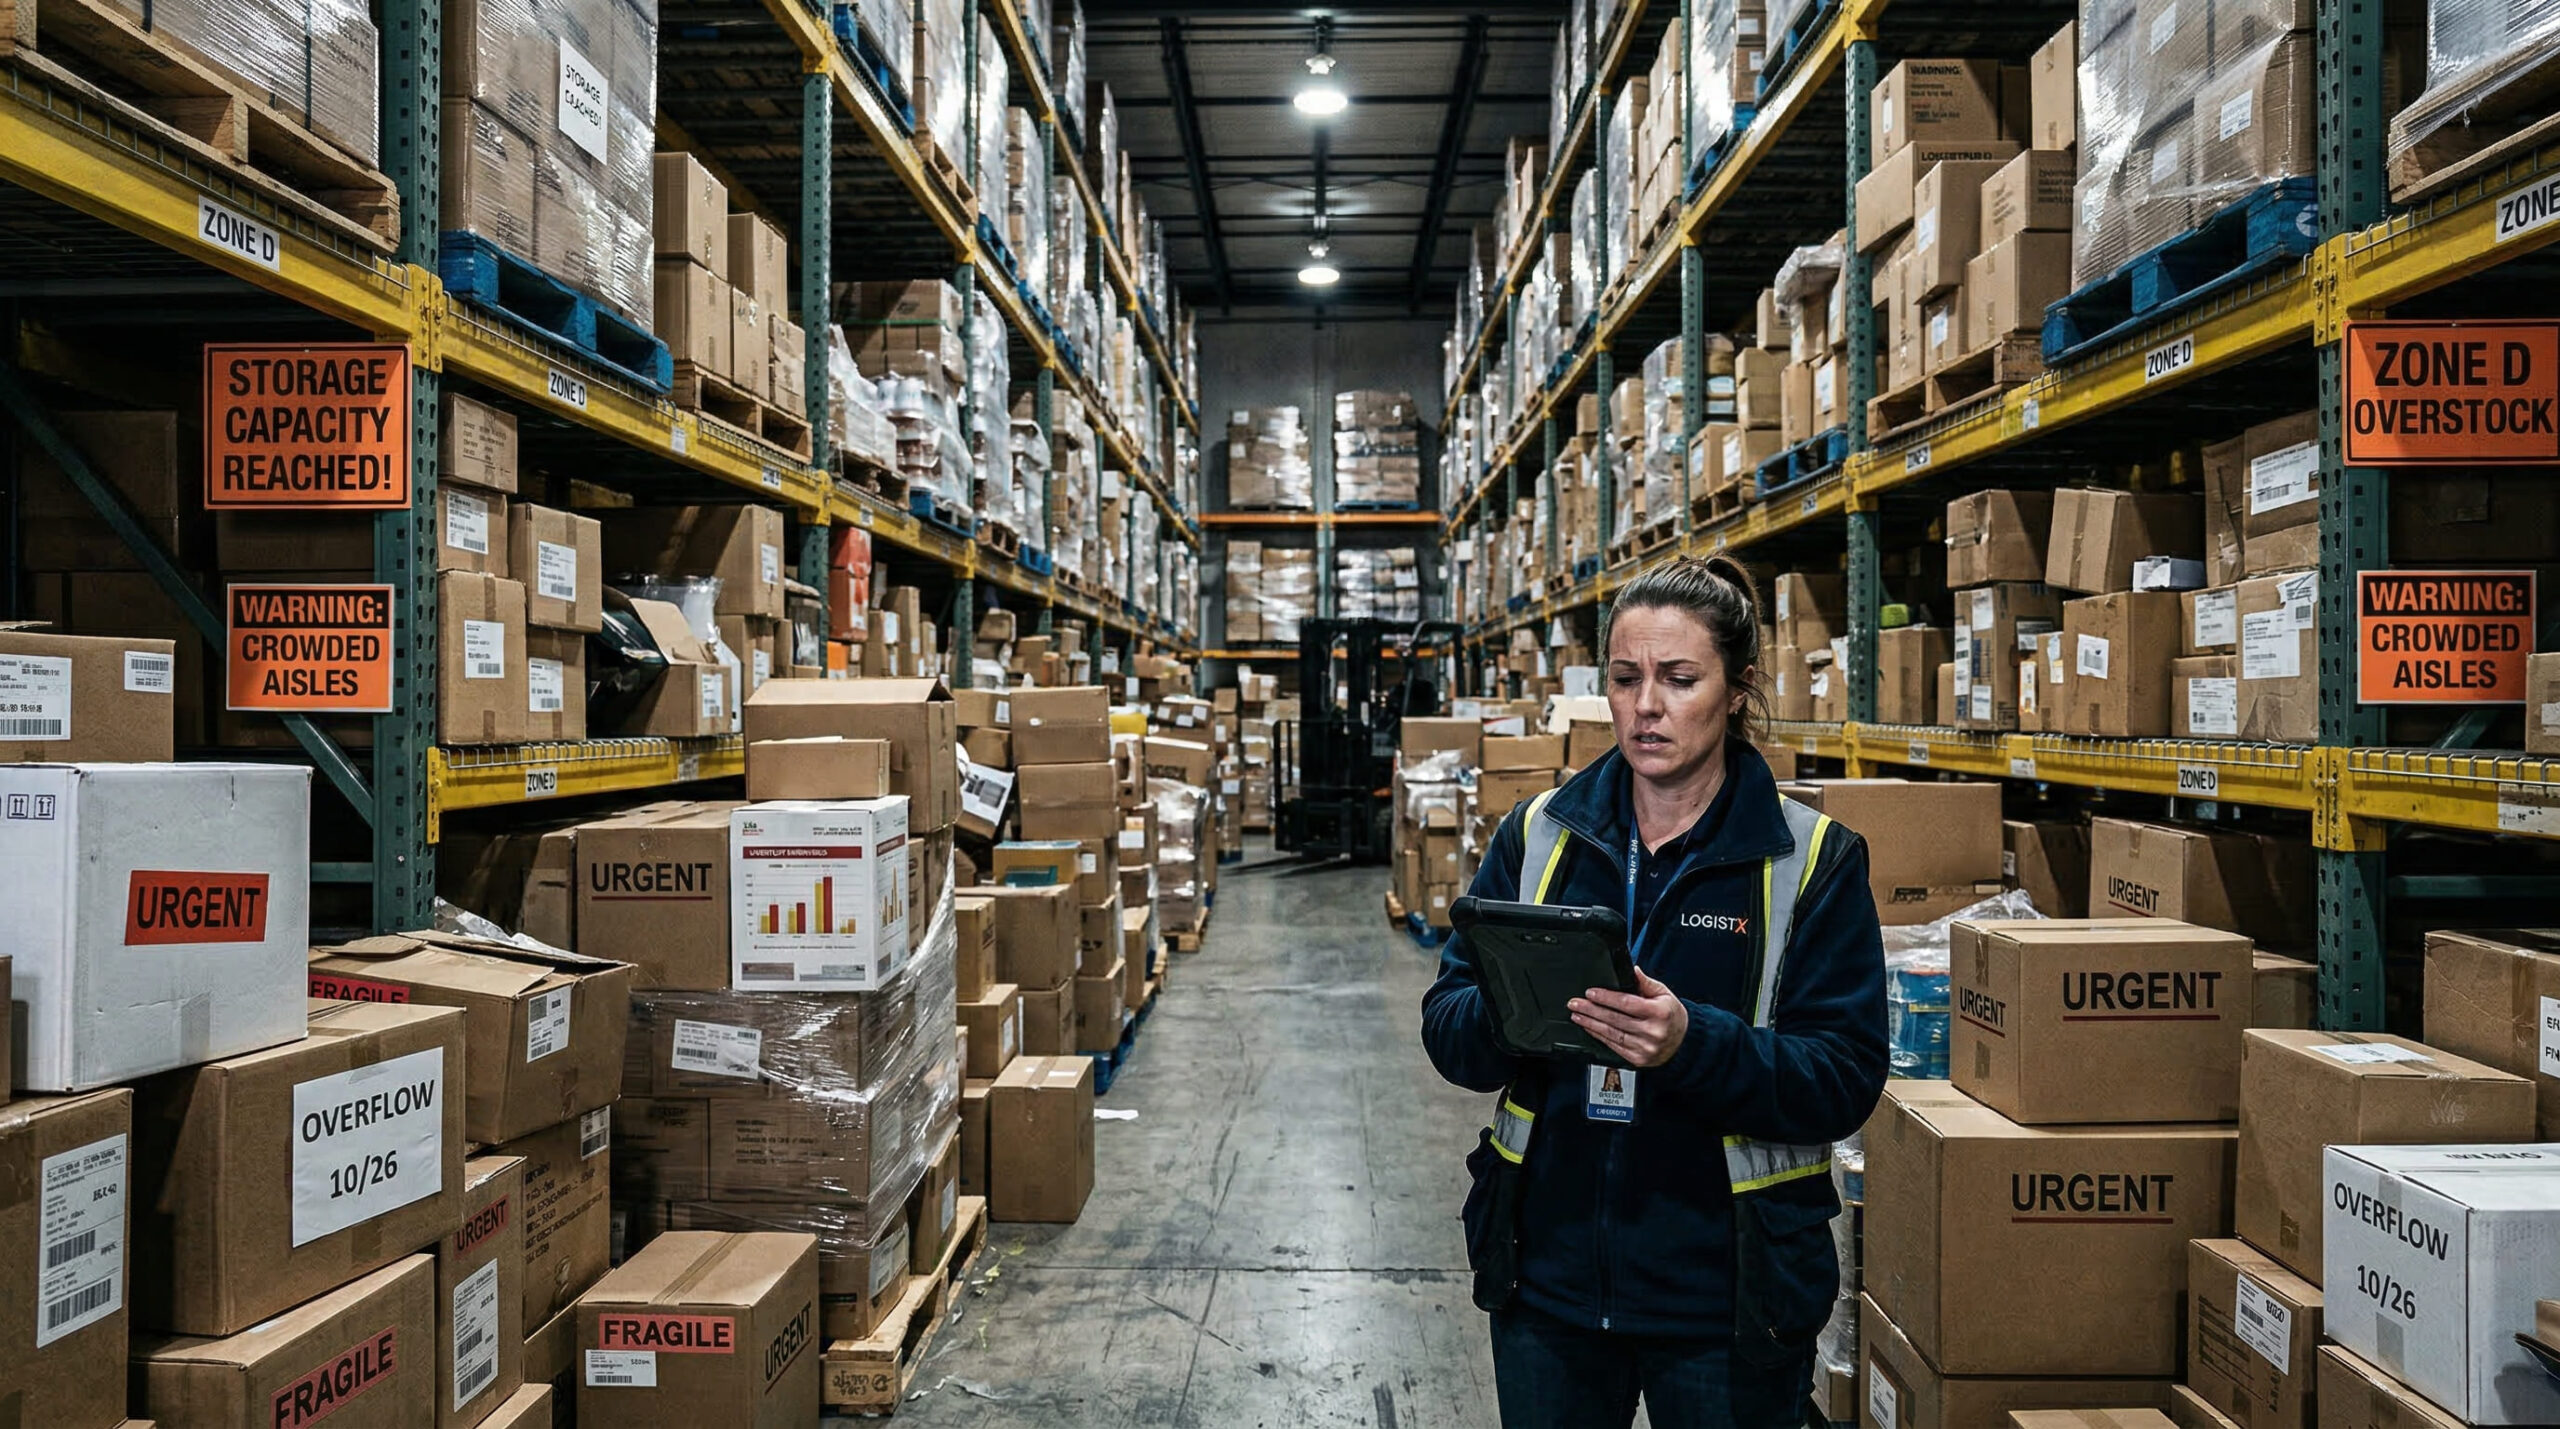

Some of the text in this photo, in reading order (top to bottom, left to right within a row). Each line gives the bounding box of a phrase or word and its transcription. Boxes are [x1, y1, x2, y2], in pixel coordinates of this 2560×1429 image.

[565, 64, 602, 105] STORAGE
[2501, 180, 2560, 234] ZONE
[204, 204, 275, 262] ZONE D
[229, 358, 387, 397] STORAGE
[2147, 339, 2192, 378] ZONE D
[2374, 341, 2532, 387] ZONE D
[550, 372, 585, 406] ZONE D
[225, 405, 391, 444] CAPACITY
[2354, 397, 2554, 435] OVERSTOCK
[223, 453, 391, 491] REACHED!
[239, 595, 384, 624] WARNING:
[2369, 582, 2524, 611] WARNING:
[241, 633, 380, 662] CROWDED
[2371, 623, 2521, 652] CROWDED
[261, 668, 359, 697] AISLES
[2392, 659, 2498, 689] AISLES
[591, 862, 713, 892] URGENT
[2108, 875, 2160, 912] URGENT
[136, 886, 261, 929] URGENT
[1680, 913, 1749, 935] LOGISTX
[1959, 986, 2006, 1028] URGENT
[2062, 971, 2222, 1011] URGENT
[301, 1079, 435, 1144] OVERFLOW
[330, 1150, 399, 1199] 10/26
[2011, 1173, 2174, 1212] URGENT
[457, 1199, 507, 1251] URGENT
[2333, 1182, 2449, 1261] OVERFLOW
[2356, 1264, 2417, 1320] 10/26
[604, 1319, 731, 1348] FRAGILE
[764, 1300, 812, 1382] URGENT
[275, 1332, 393, 1429] FRAGILE
